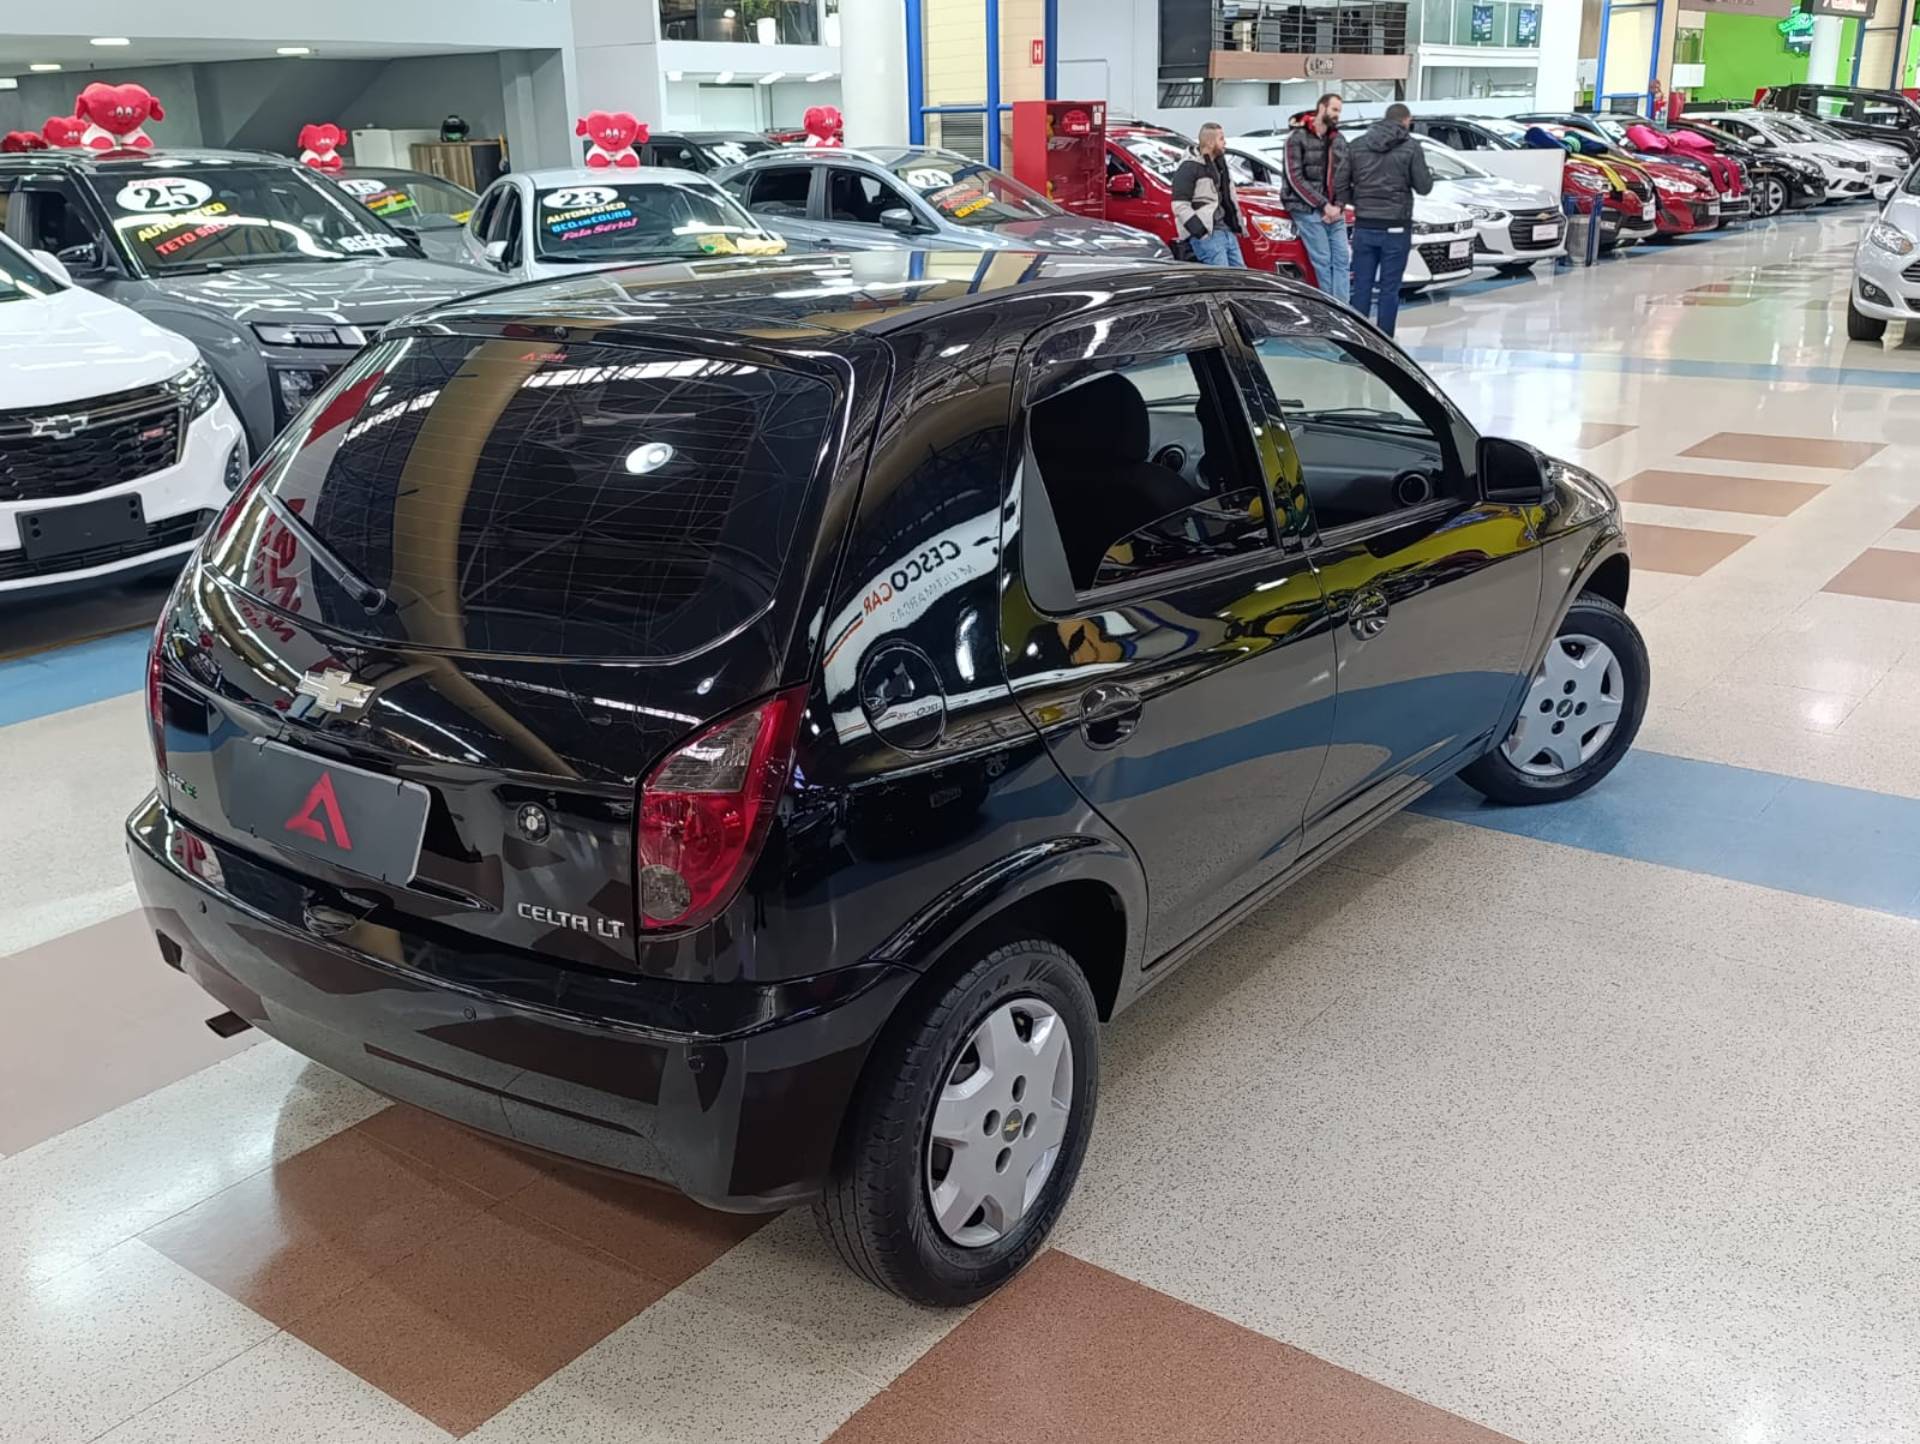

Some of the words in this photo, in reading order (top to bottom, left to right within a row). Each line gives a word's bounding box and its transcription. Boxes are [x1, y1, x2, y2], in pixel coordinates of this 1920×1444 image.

[1033, 42, 1043, 61] H
[914, 172, 950, 187] 24
[133, 184, 199, 209] 25
[559, 191, 606, 207] 23
[137, 202, 227, 242] AUTOTICO
[155, 232, 197, 255] TETO
[194, 214, 240, 239] SOL
[517, 902, 589, 932] CELTA
[597, 917, 625, 939] LT
